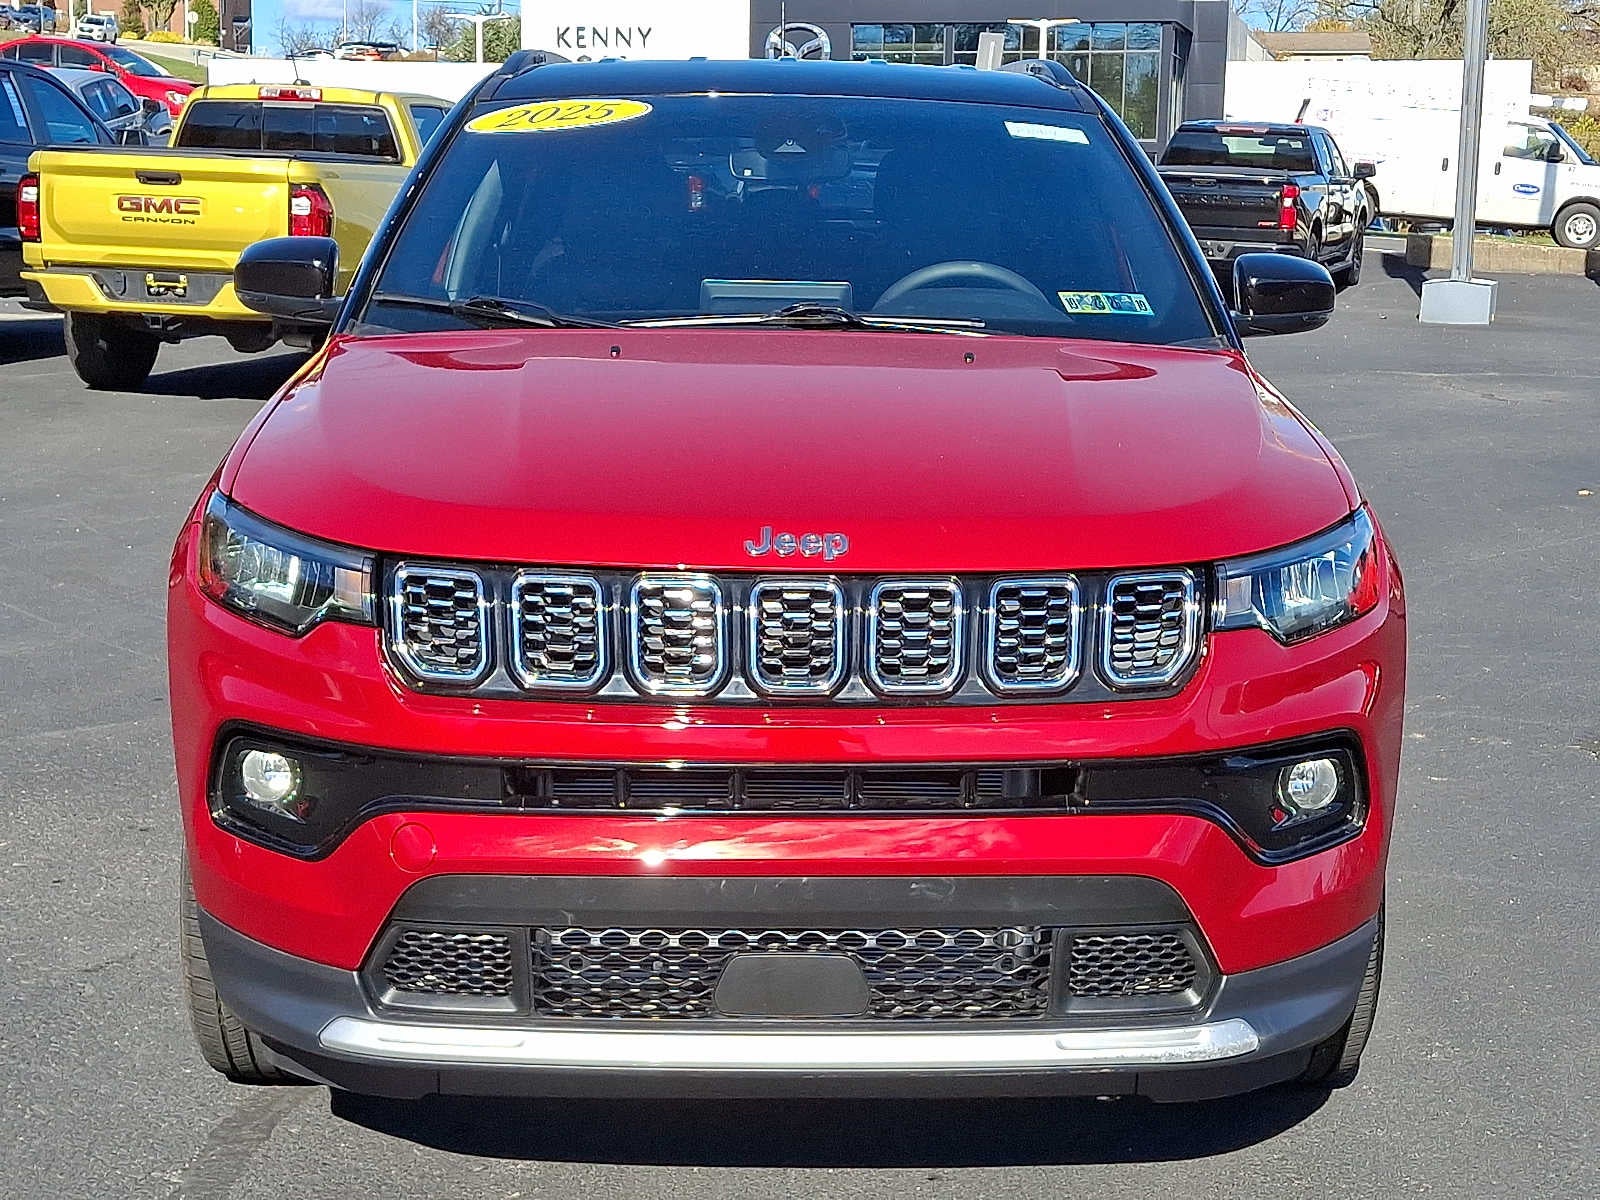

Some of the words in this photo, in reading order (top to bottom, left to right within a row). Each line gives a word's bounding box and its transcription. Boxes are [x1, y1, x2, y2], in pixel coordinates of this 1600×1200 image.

[556, 26, 652, 49] KENNY
[495, 103, 621, 128] 2025
[117, 196, 201, 215] GMC
[121, 216, 196, 225] CANYON
[743, 525, 849, 562] Jeep
